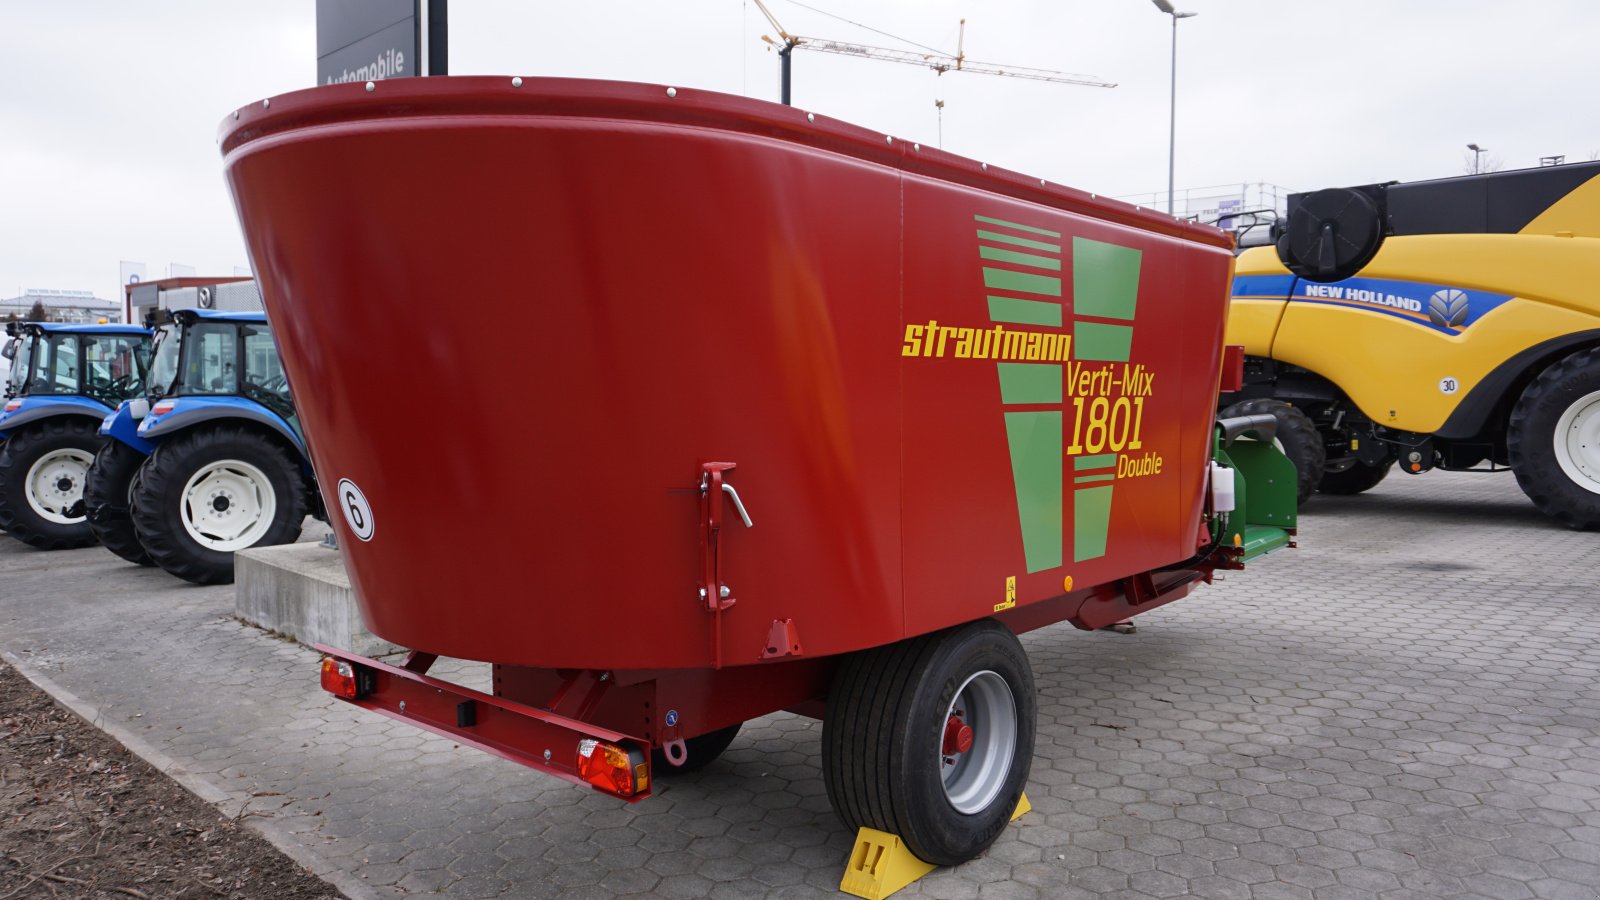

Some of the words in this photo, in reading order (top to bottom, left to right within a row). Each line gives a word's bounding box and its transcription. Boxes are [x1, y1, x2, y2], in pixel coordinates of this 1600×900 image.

[1306, 284, 1343, 298] NEW
[1345, 287, 1422, 312] HOLLAND
[901, 319, 1072, 362] strautmann
[1067, 361, 1155, 397] Verti-Mix
[1442, 379, 1455, 392] 30
[1066, 396, 1144, 455] 1801
[1117, 451, 1163, 479] Double
[346, 491, 364, 529] 6
